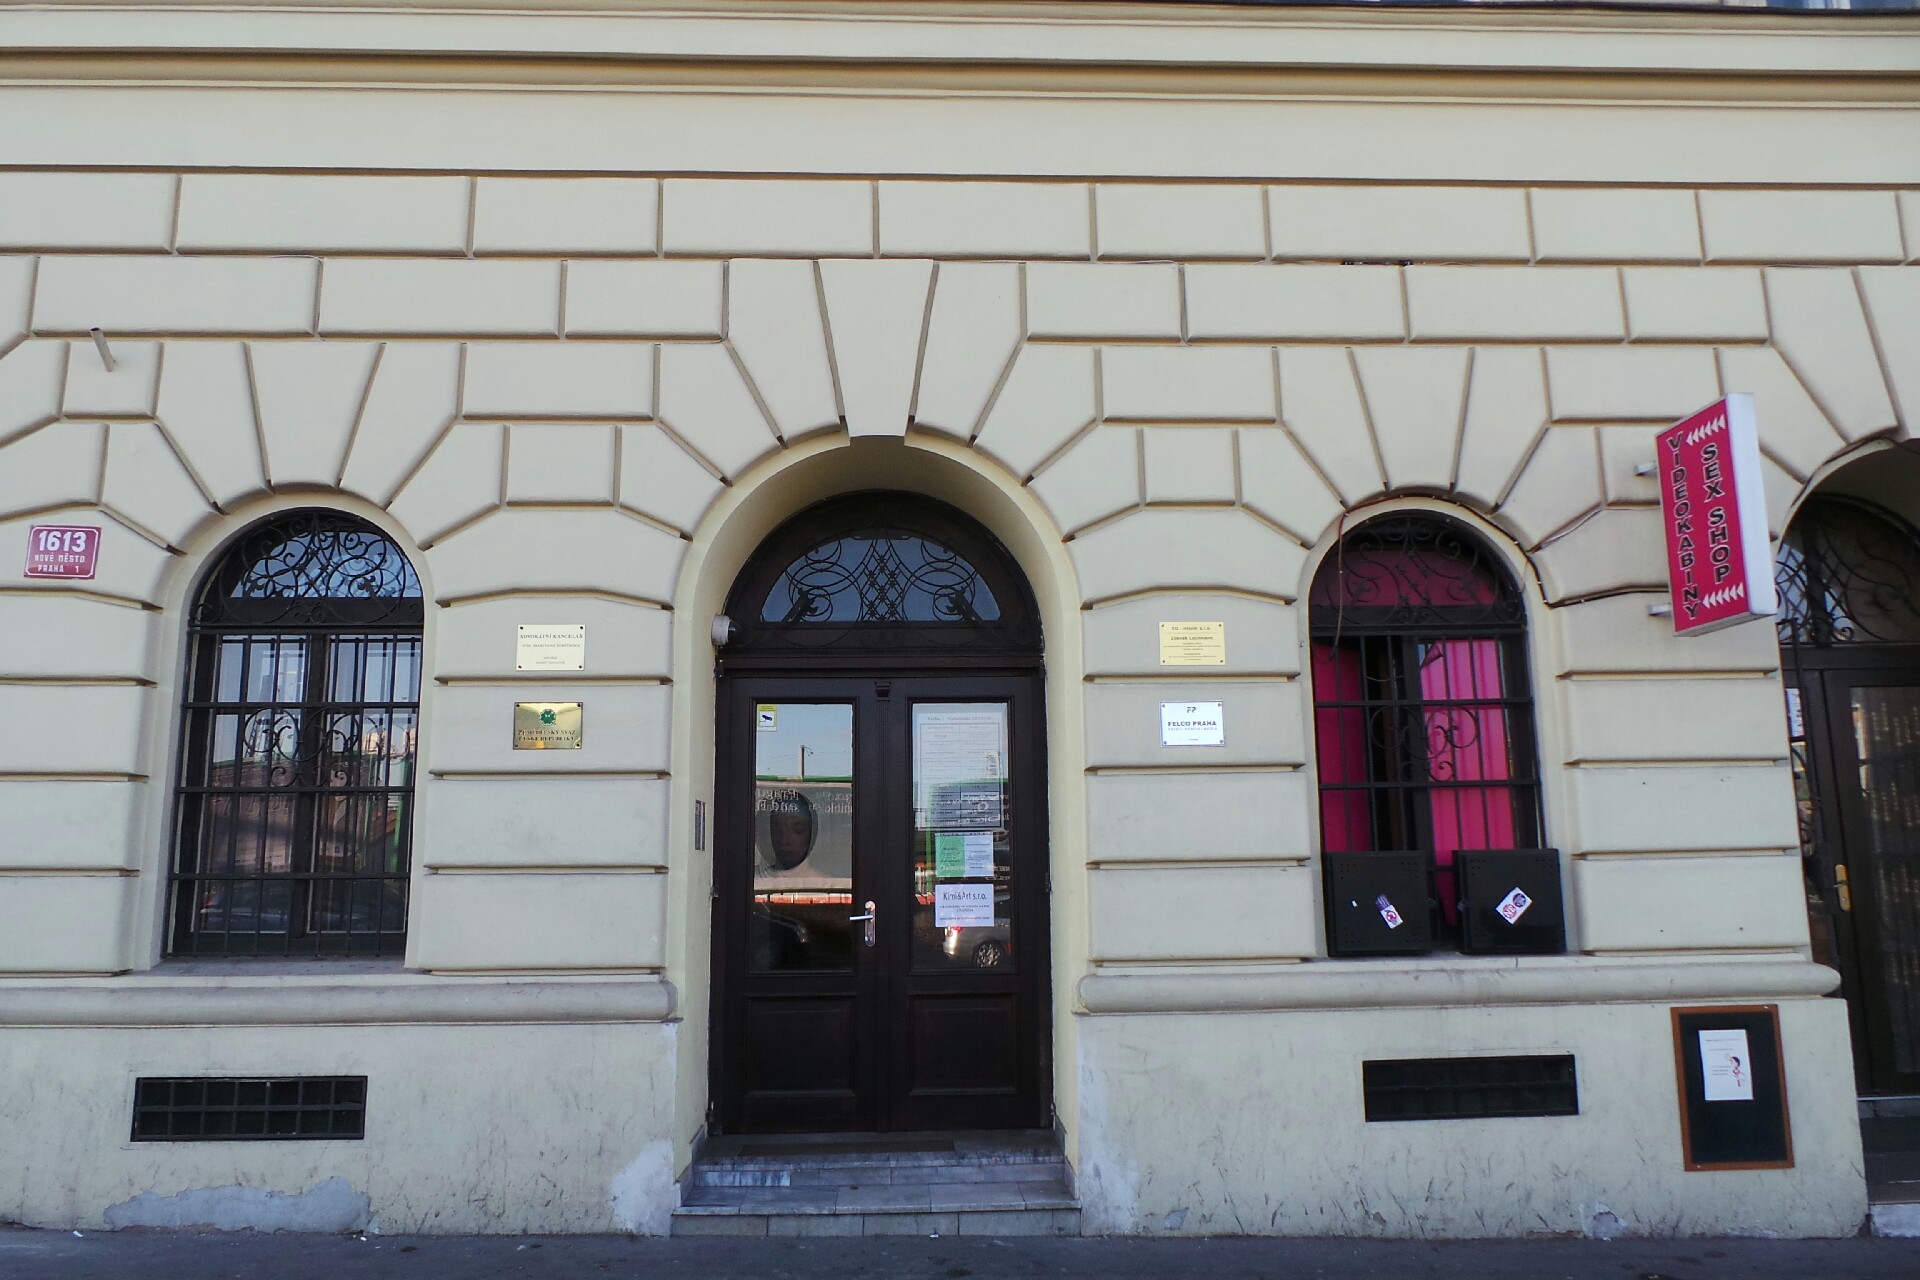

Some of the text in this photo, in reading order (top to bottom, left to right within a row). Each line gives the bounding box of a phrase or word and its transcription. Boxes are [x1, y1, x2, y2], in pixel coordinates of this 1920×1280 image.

[1700, 442, 1733, 585] SEX SHOP
[1666, 430, 1702, 621] VIDEOKABINY
[39, 530, 87, 553] 1613
[34, 552, 85, 563] NOVÉ MĚSTO
[37, 565, 79, 573] PRAHA 1
